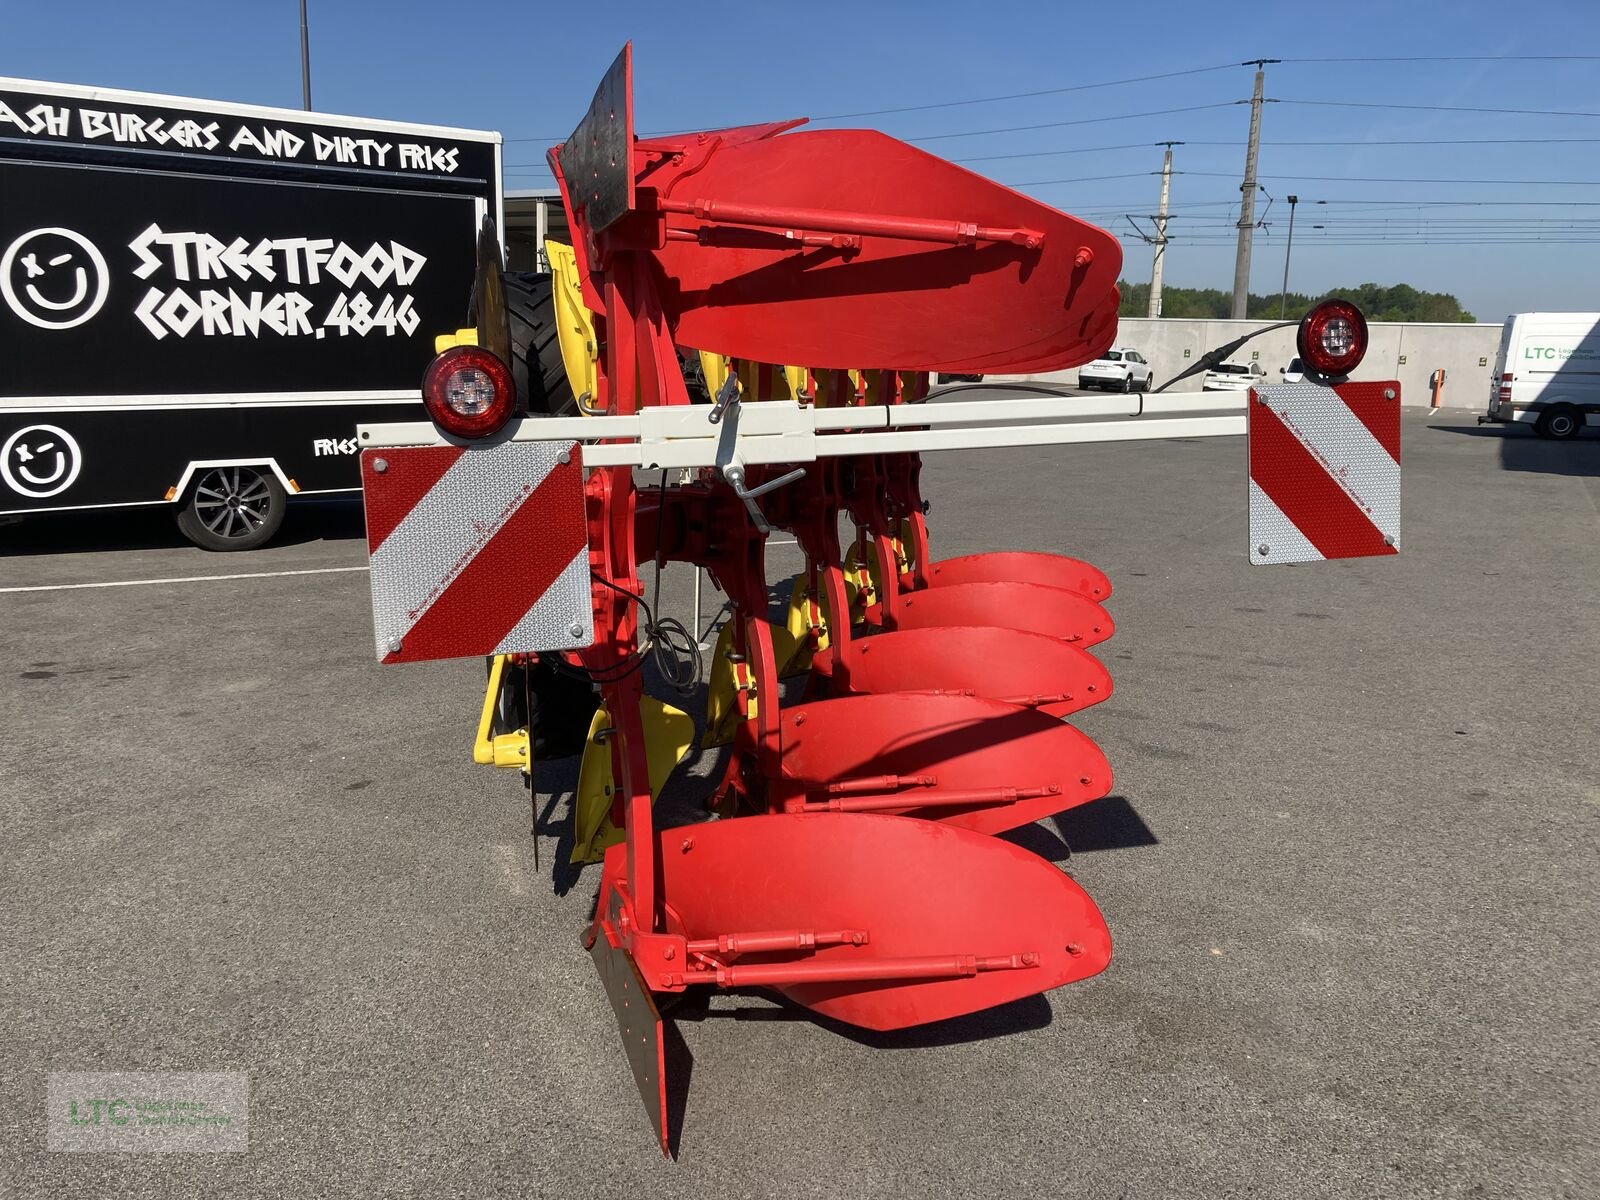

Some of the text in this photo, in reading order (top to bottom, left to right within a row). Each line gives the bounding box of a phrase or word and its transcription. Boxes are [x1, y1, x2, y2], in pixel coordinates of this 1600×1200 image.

[79, 108, 220, 151] BURGERS
[229, 125, 305, 158] AND
[312, 132, 393, 167] DIRTY
[399, 143, 460, 173] FRIES
[128, 222, 427, 289] STREETFOOD
[134, 286, 421, 340] CORNER.4846
[1525, 347, 1556, 359] LTC
[313, 437, 358, 457] FRIES
